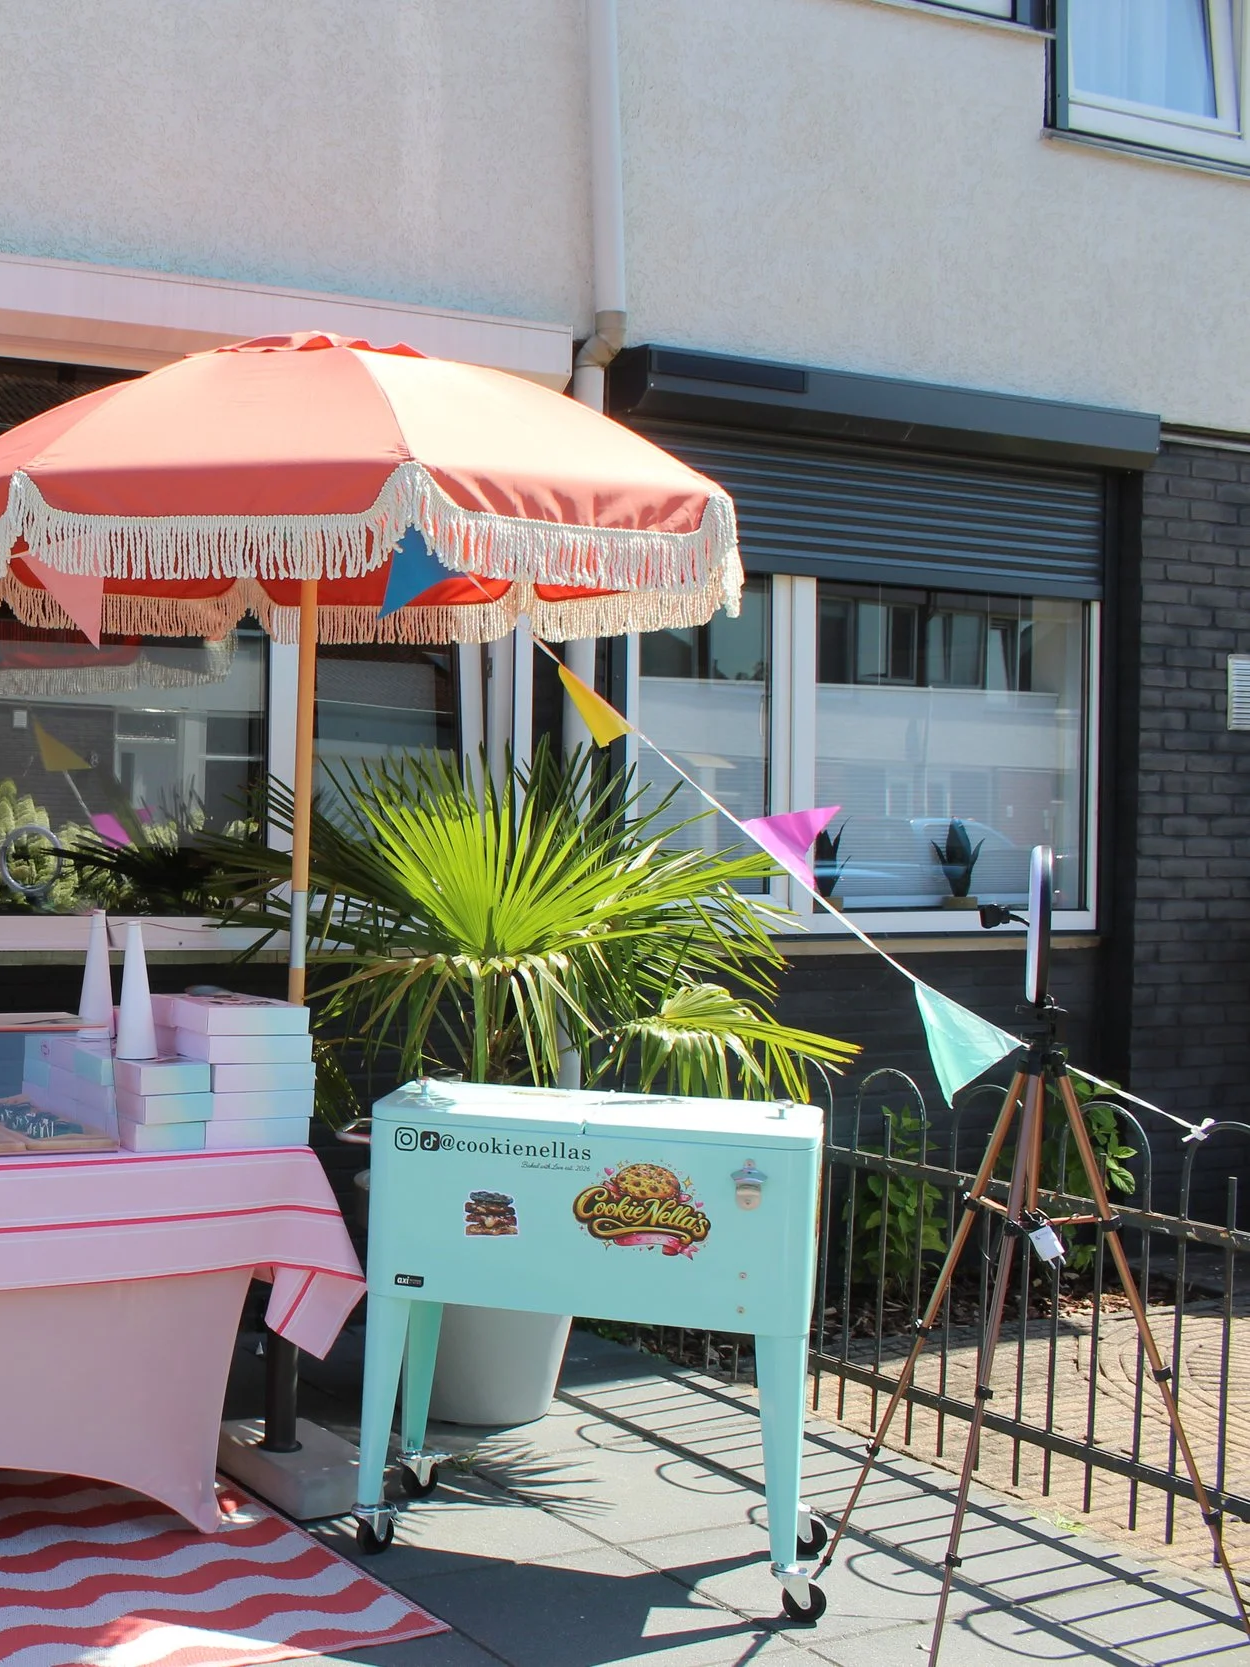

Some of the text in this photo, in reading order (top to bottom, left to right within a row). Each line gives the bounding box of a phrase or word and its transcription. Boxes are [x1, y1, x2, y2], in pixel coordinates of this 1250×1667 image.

[440, 1134, 592, 1161] @cookienellas
[575, 1186, 710, 1240] CookieNella's
[396, 1275, 410, 1285] axi
